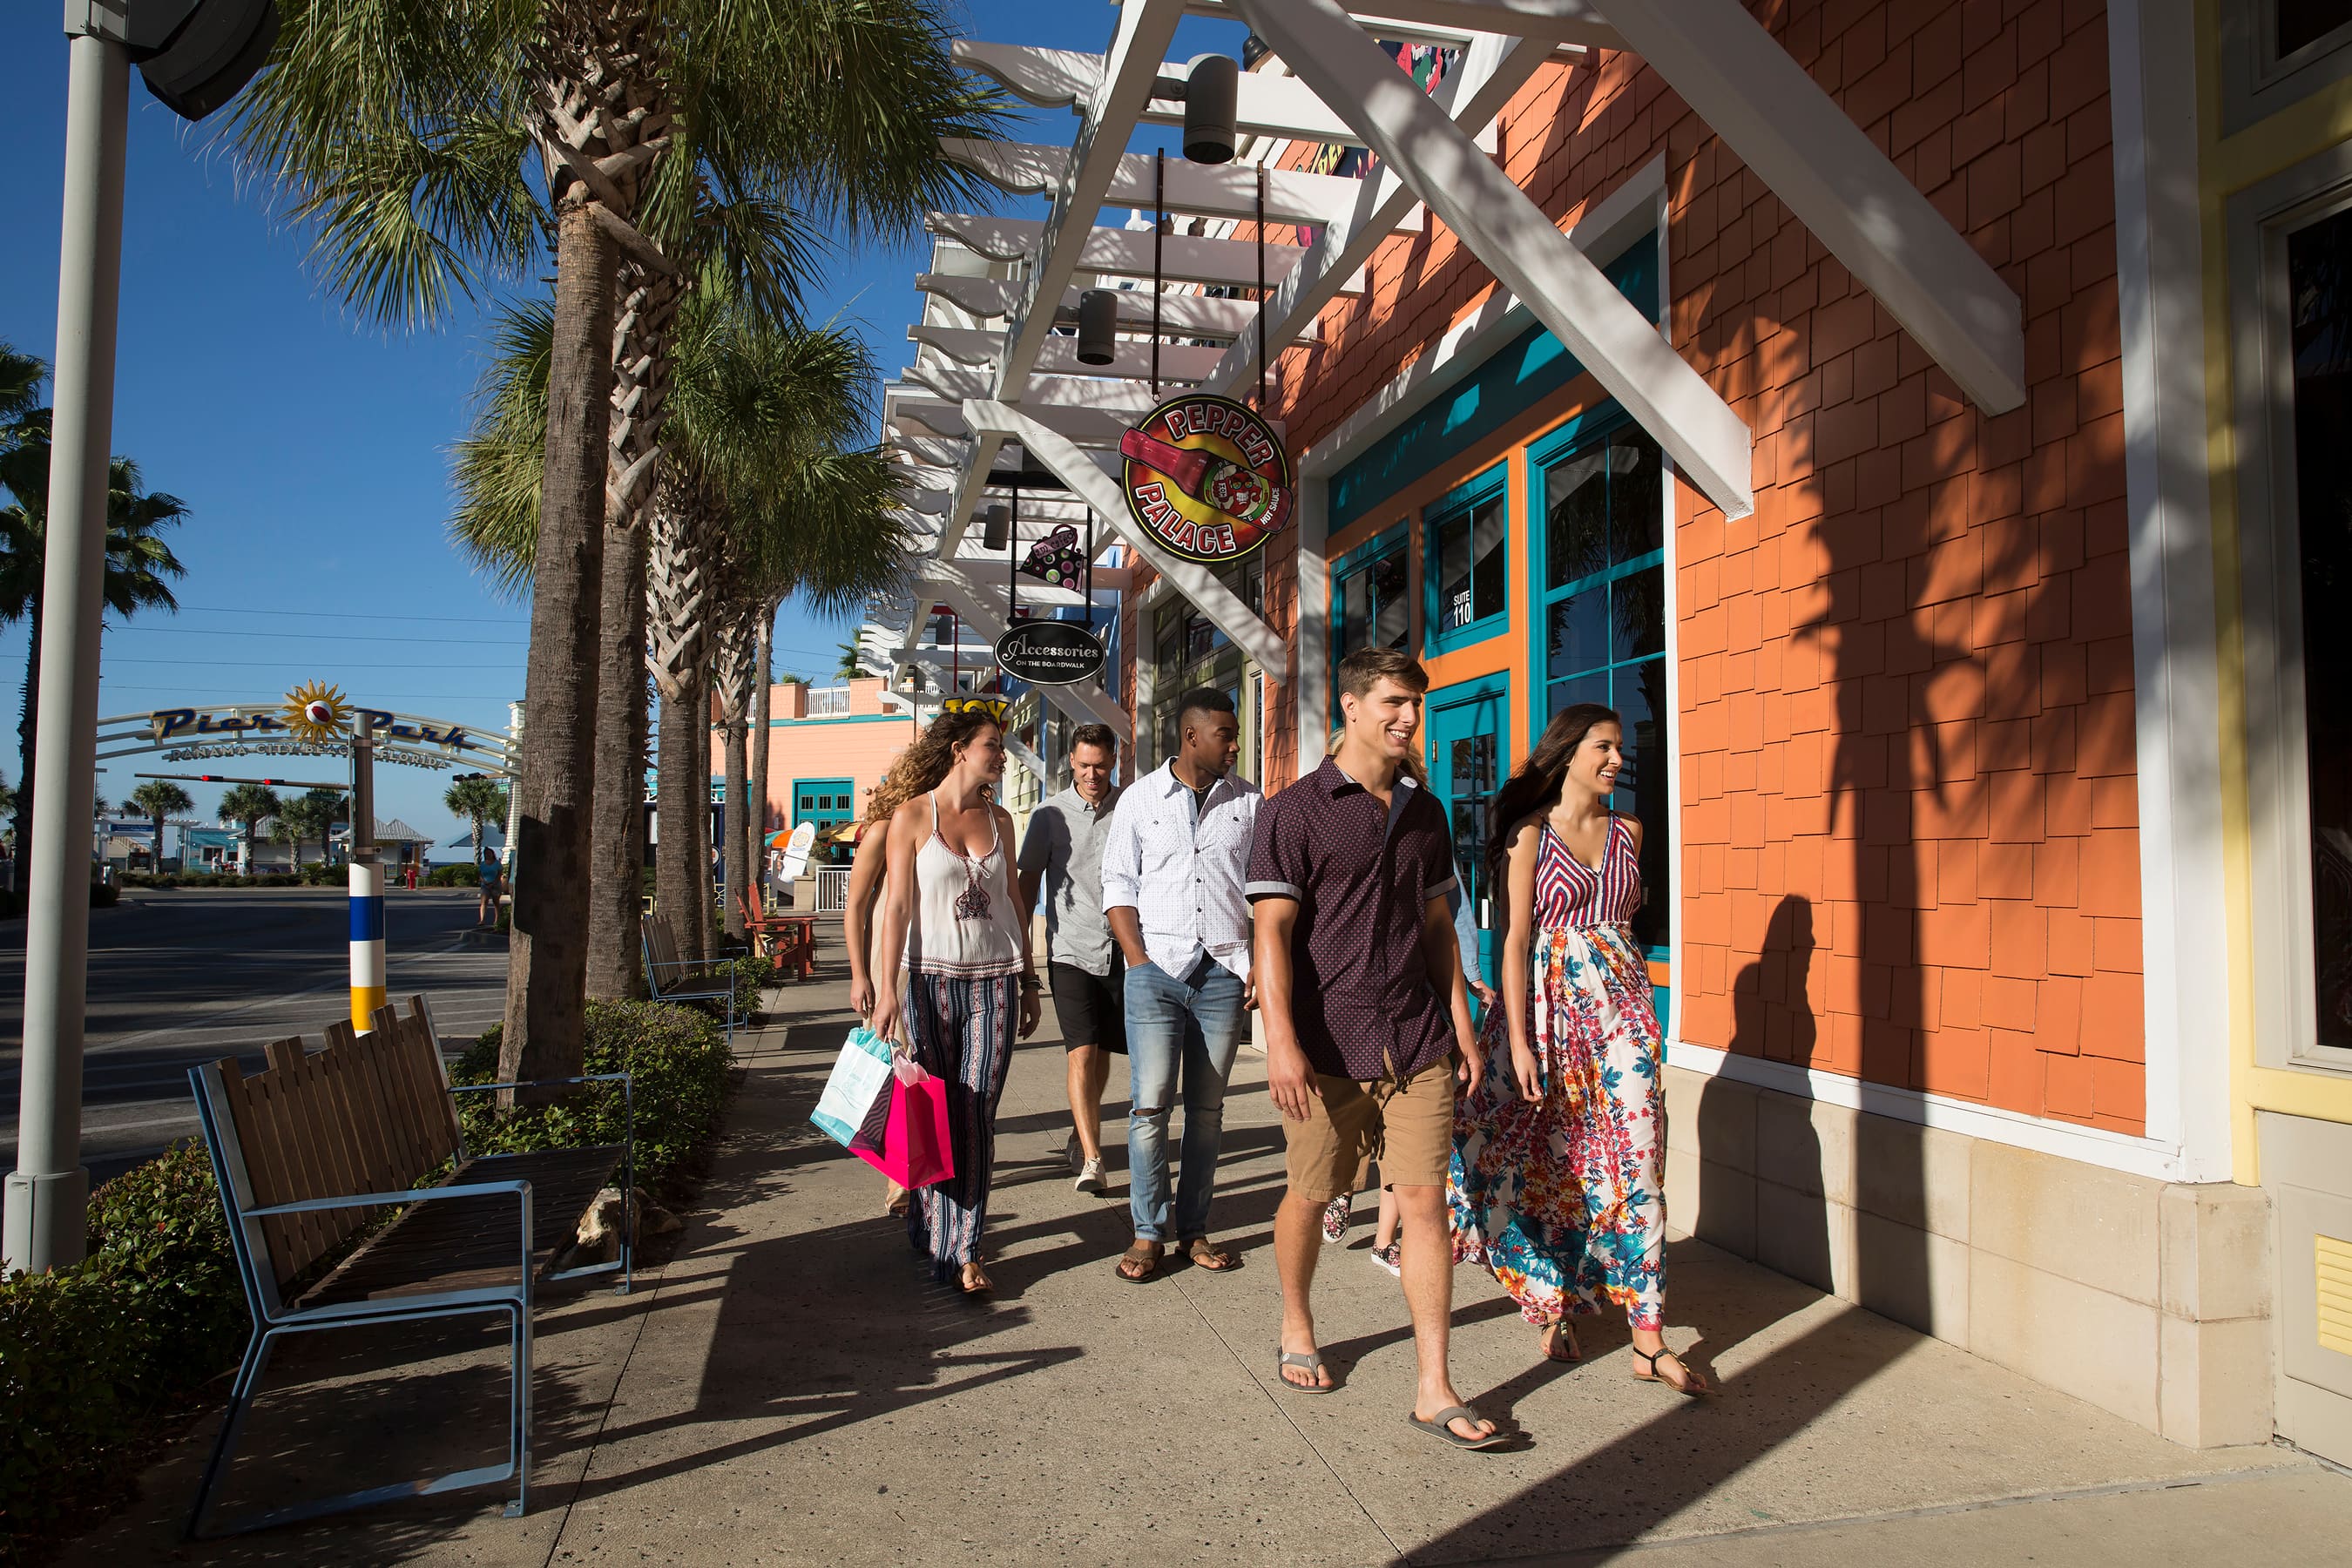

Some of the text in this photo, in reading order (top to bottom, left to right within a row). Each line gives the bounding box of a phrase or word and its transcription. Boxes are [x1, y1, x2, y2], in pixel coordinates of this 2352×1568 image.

[1166, 404, 1274, 467] PEPPER
[1136, 482, 1236, 554] PALACE
[1260, 488, 1280, 525] HOT SAUCE
[1453, 590, 1470, 606] SUITE
[1453, 602, 1471, 627] 110
[1002, 633, 1099, 661] Accessories
[1042, 660, 1085, 669] BOARDWALK
[943, 697, 1010, 725] TOY
[151, 707, 479, 750] Pier Park
[172, 744, 448, 768] PANAMA CITY BEAC FLORIDA
